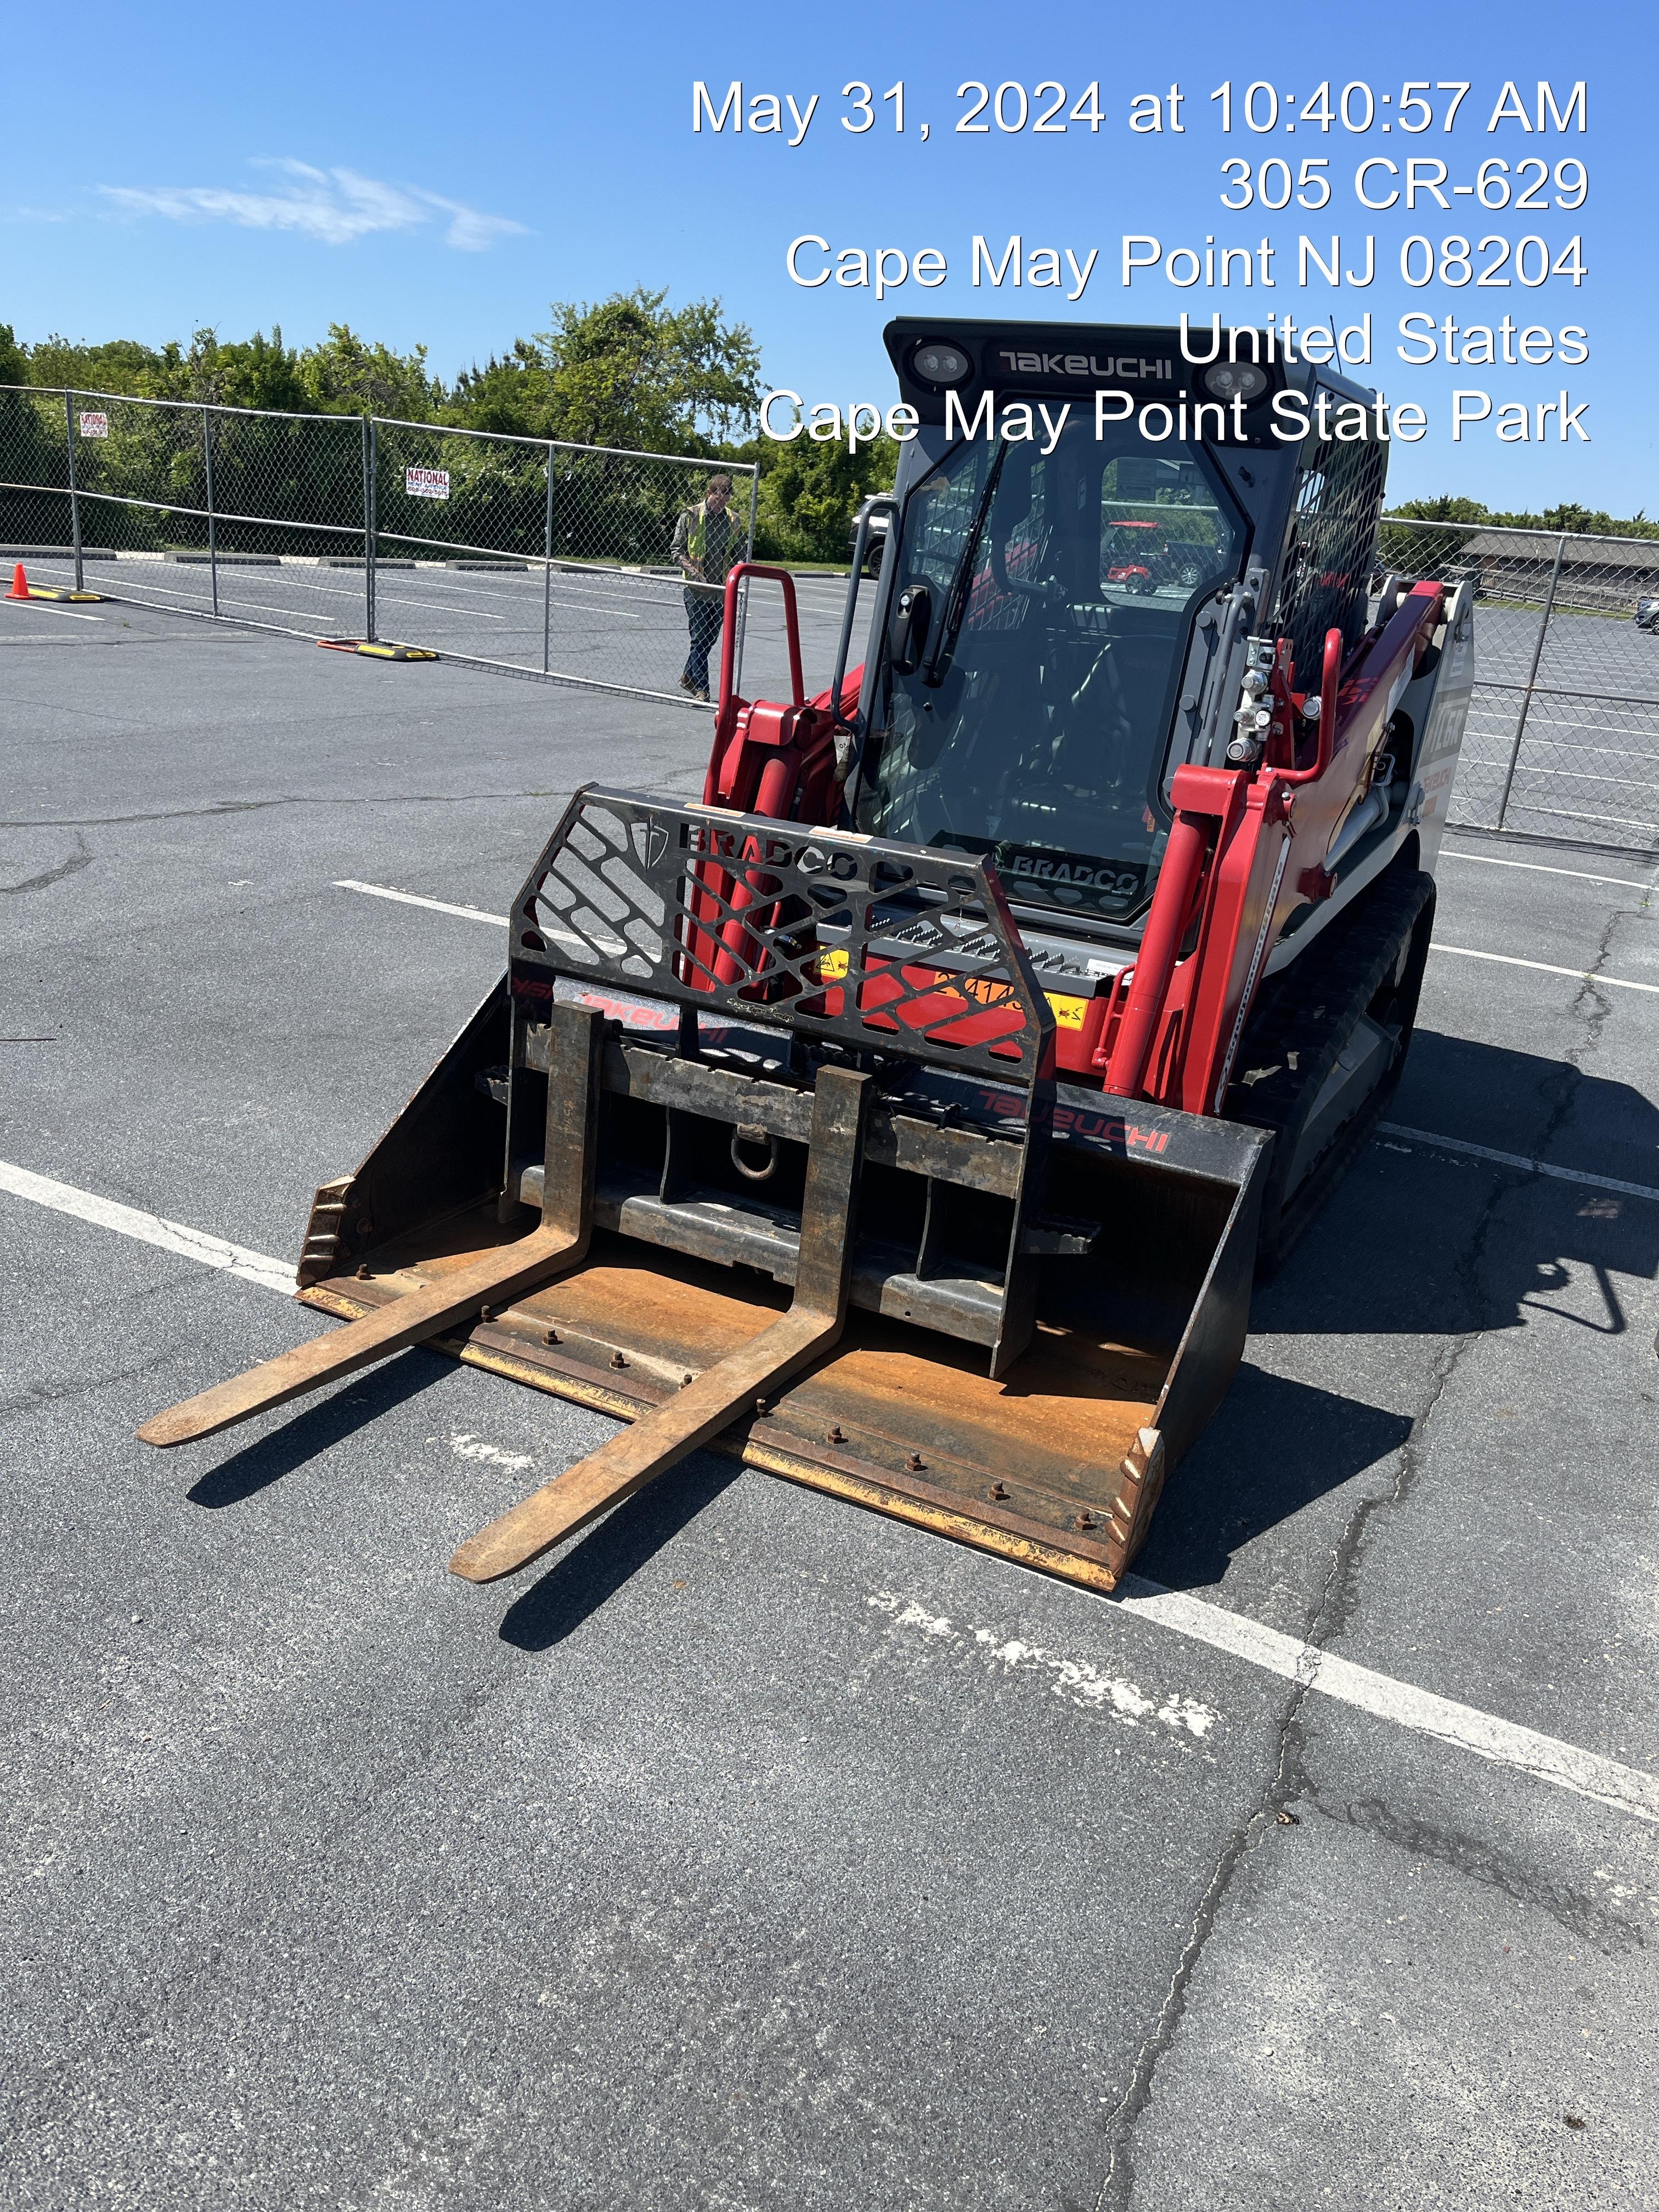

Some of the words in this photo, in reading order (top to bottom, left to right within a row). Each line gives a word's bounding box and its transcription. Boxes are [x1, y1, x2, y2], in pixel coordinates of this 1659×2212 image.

[408, 469, 448, 486] NATIONAL
[679, 823, 858, 881] BRADCO
[1012, 856, 1139, 893] BRADCO
[1227, 861, 1283, 1063] EquipmentShare
[979, 1090, 1169, 1152] TaeUCHI
